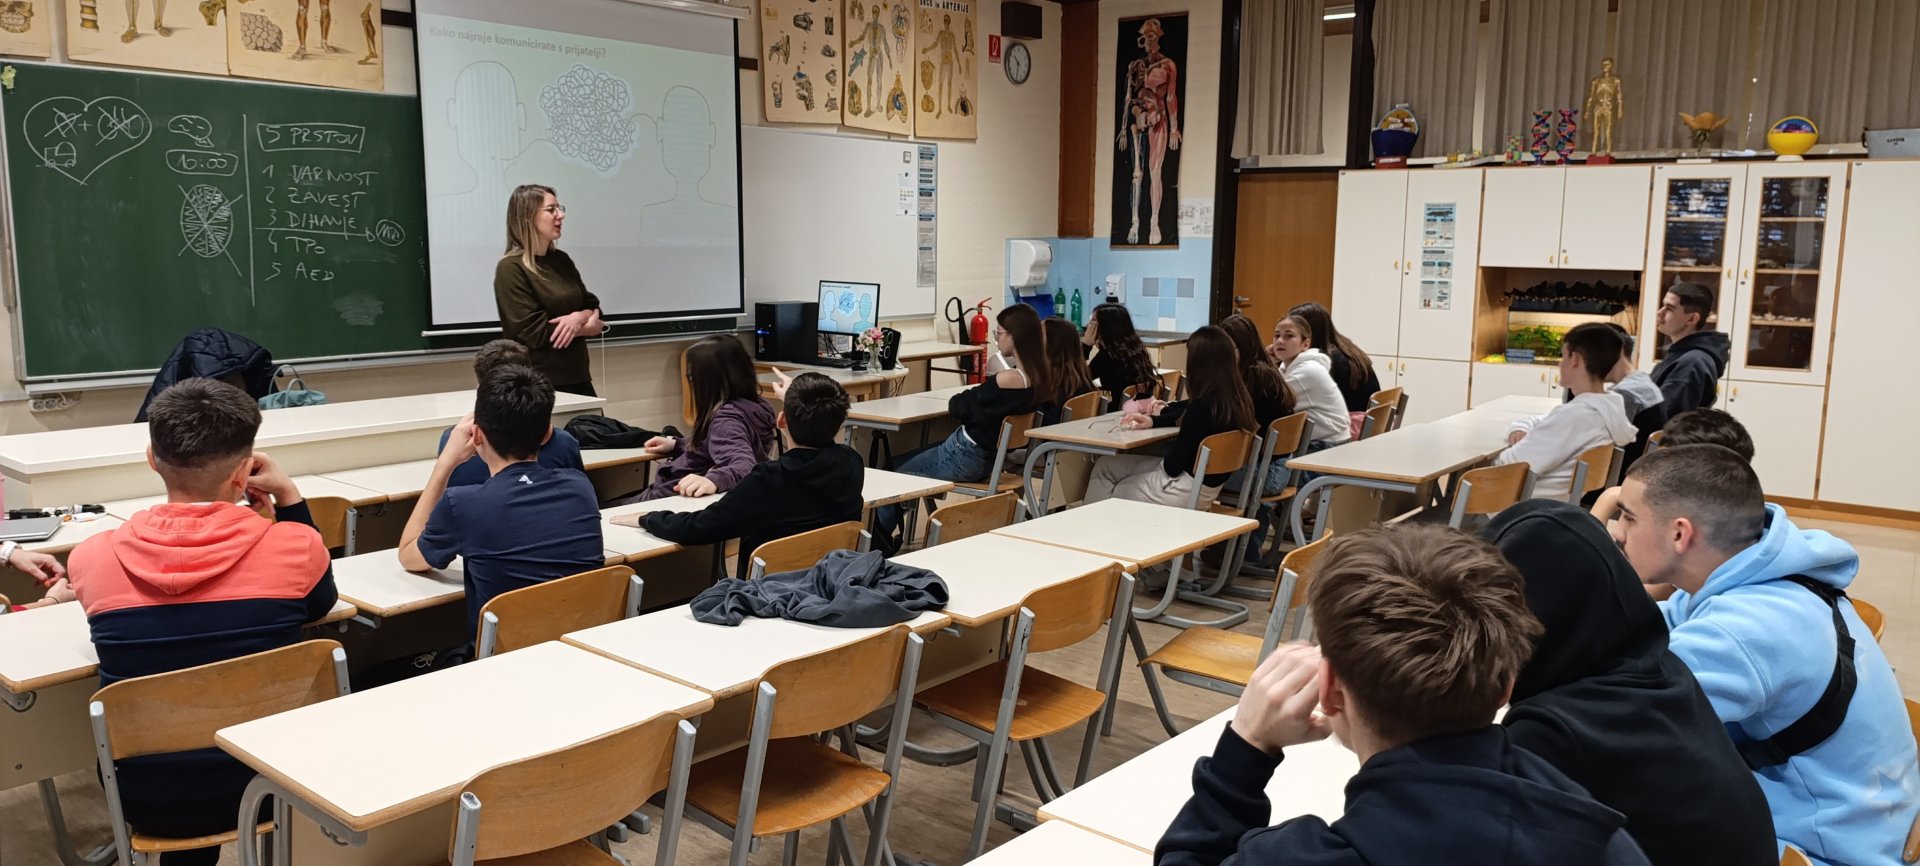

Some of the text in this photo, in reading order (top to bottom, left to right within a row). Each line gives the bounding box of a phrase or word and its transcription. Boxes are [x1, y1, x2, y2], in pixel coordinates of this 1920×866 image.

[942, 1, 969, 13] ARTERIJE
[429, 26, 455, 38] Kako
[458, 30, 493, 45] najraje
[495, 33, 556, 51] komunicirate
[558, 45, 563, 53] s
[265, 126, 358, 146] 5 PRSTOV
[262, 164, 379, 186] 1 VARNOST
[265, 186, 367, 208] 2 ZAVEST
[268, 209, 277, 226] 3
[285, 236, 326, 254] TPO
[265, 262, 335, 281] 5 AED
